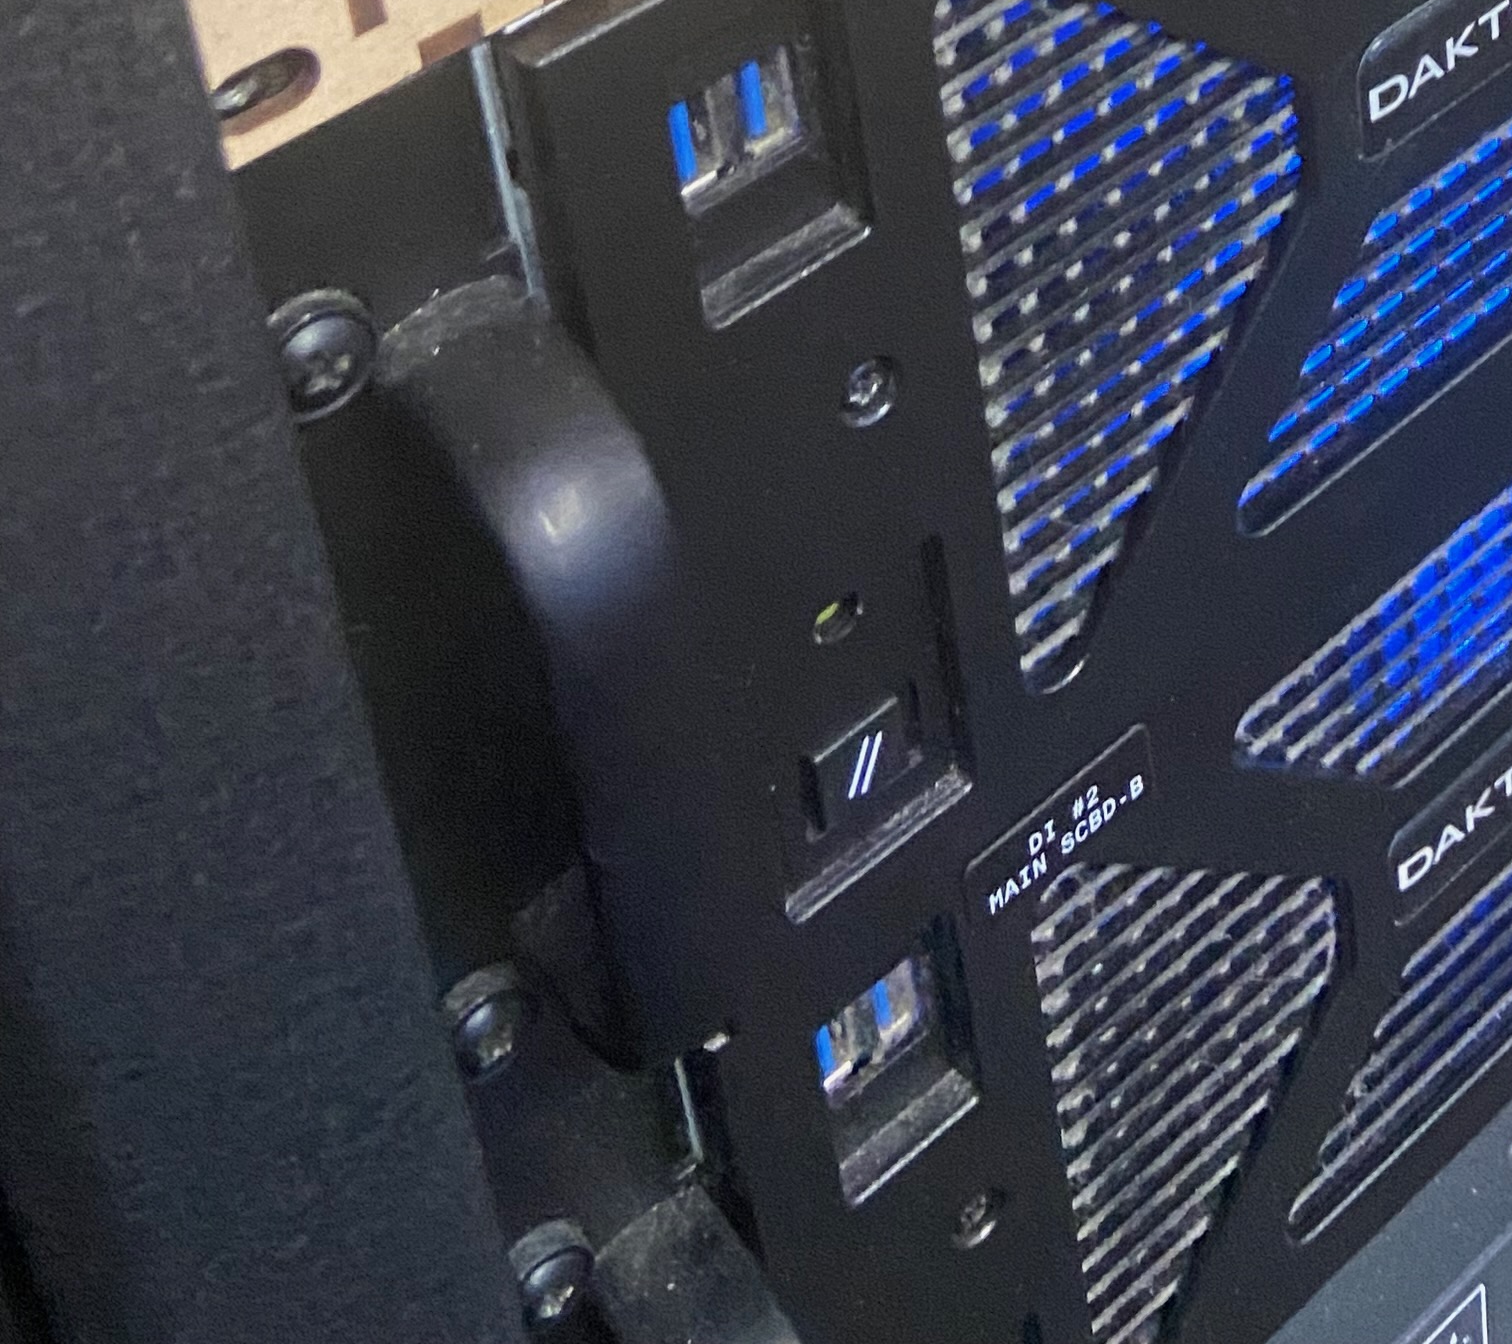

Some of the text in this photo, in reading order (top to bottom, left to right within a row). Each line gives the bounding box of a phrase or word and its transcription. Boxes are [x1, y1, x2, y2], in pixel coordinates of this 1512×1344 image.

[988, 774, 1144, 915] MAIN SCBD-B
[1028, 784, 1099, 856] DI #2
